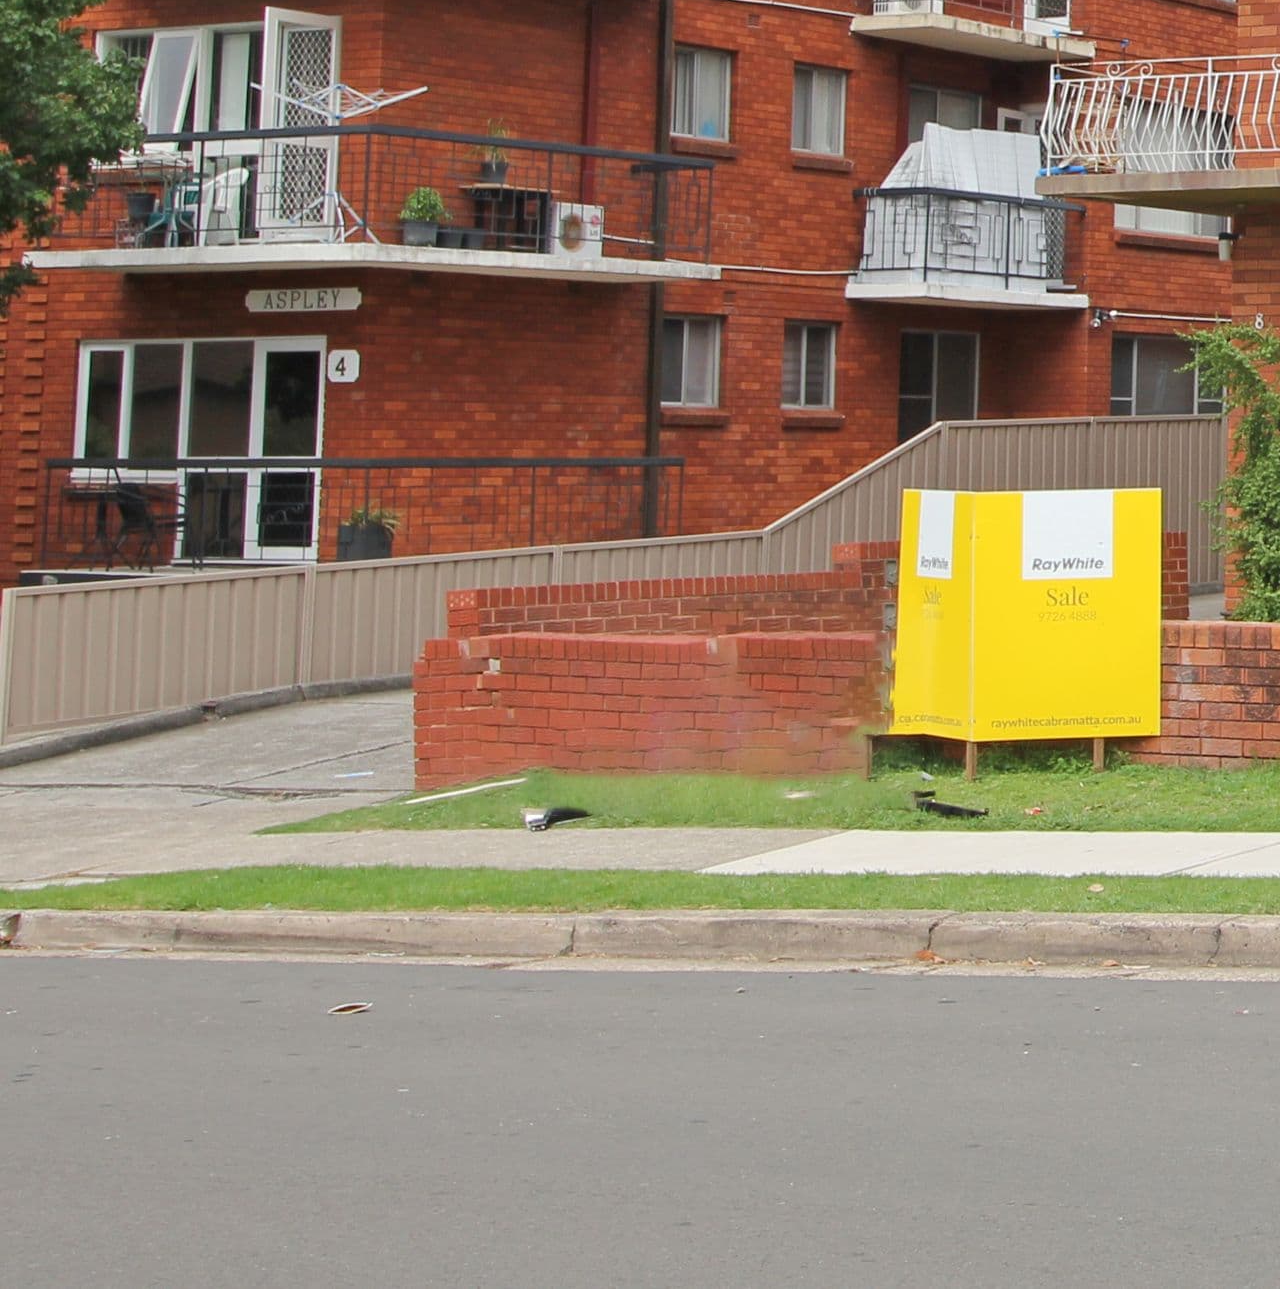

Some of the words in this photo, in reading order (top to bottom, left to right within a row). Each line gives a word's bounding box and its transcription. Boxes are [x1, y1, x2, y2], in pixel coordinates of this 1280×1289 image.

[263, 288, 341, 310] ASPLEY
[1254, 312, 1264, 329] 8
[335, 356, 346, 377] 4
[1031, 556, 1105, 573] RayWhite
[923, 583, 942, 606] Sale
[1045, 586, 1089, 607] Sale
[991, 713, 1142, 729] raywhitecabramatta.com.au
